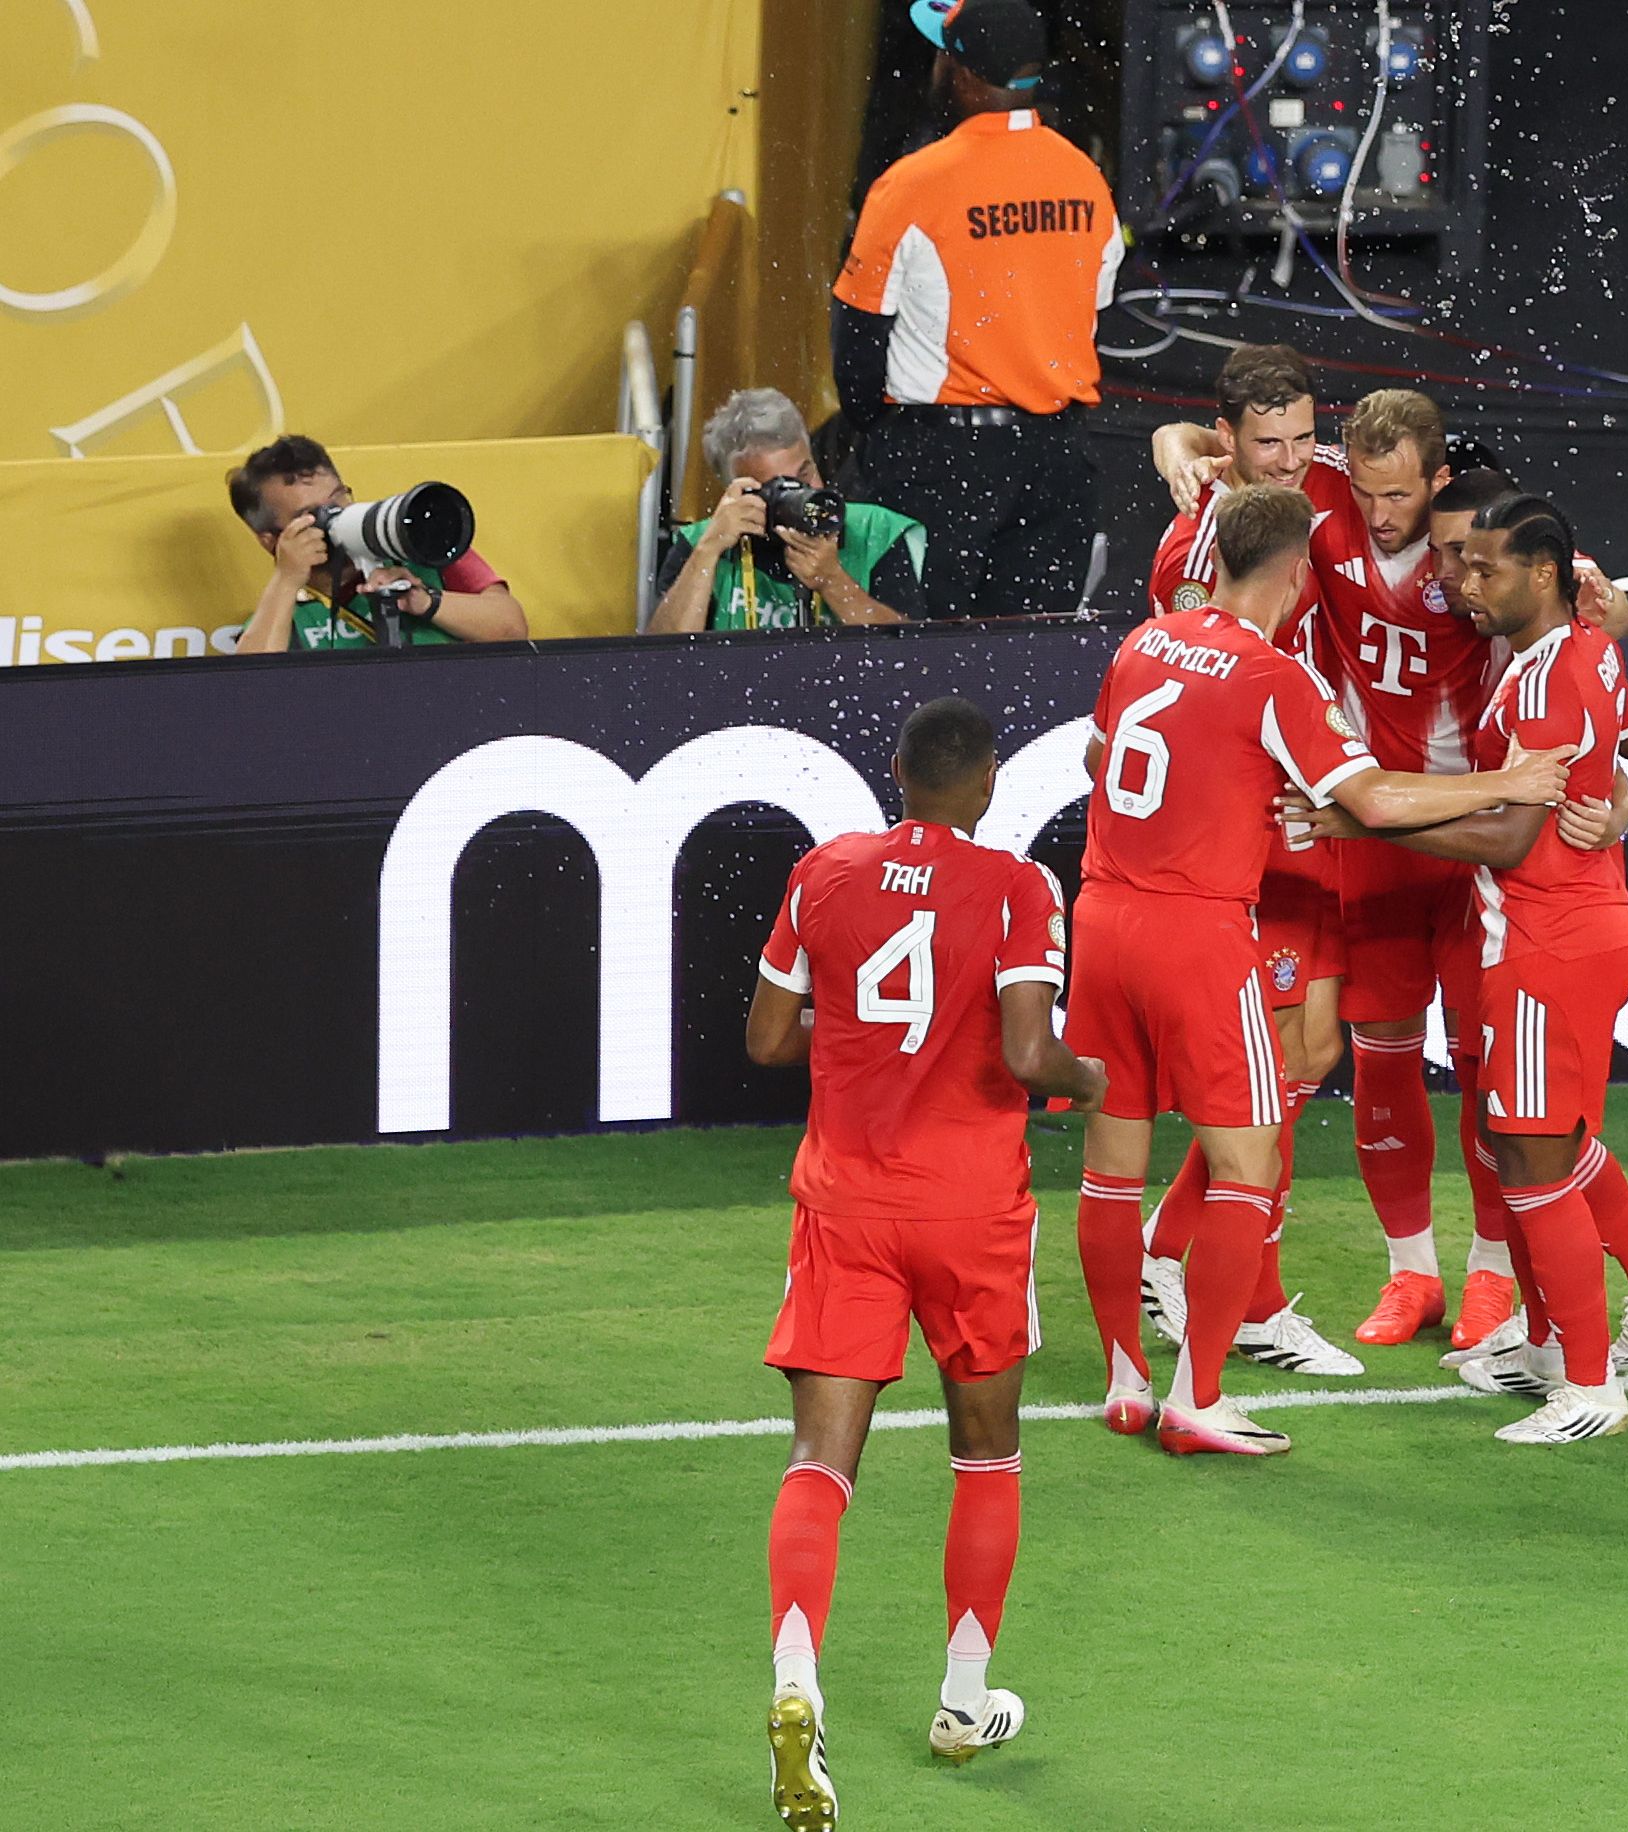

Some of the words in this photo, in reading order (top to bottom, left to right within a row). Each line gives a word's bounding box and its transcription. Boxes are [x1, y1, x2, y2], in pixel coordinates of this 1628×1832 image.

[967, 198, 1094, 240] SECURITY
[731, 587, 797, 628] PHO
[303, 617, 364, 649] PHO
[1133, 627, 1239, 680] KIMMICH
[1105, 678, 1185, 820] 6
[880, 861, 933, 895] TAH
[857, 910, 936, 1054] 4
